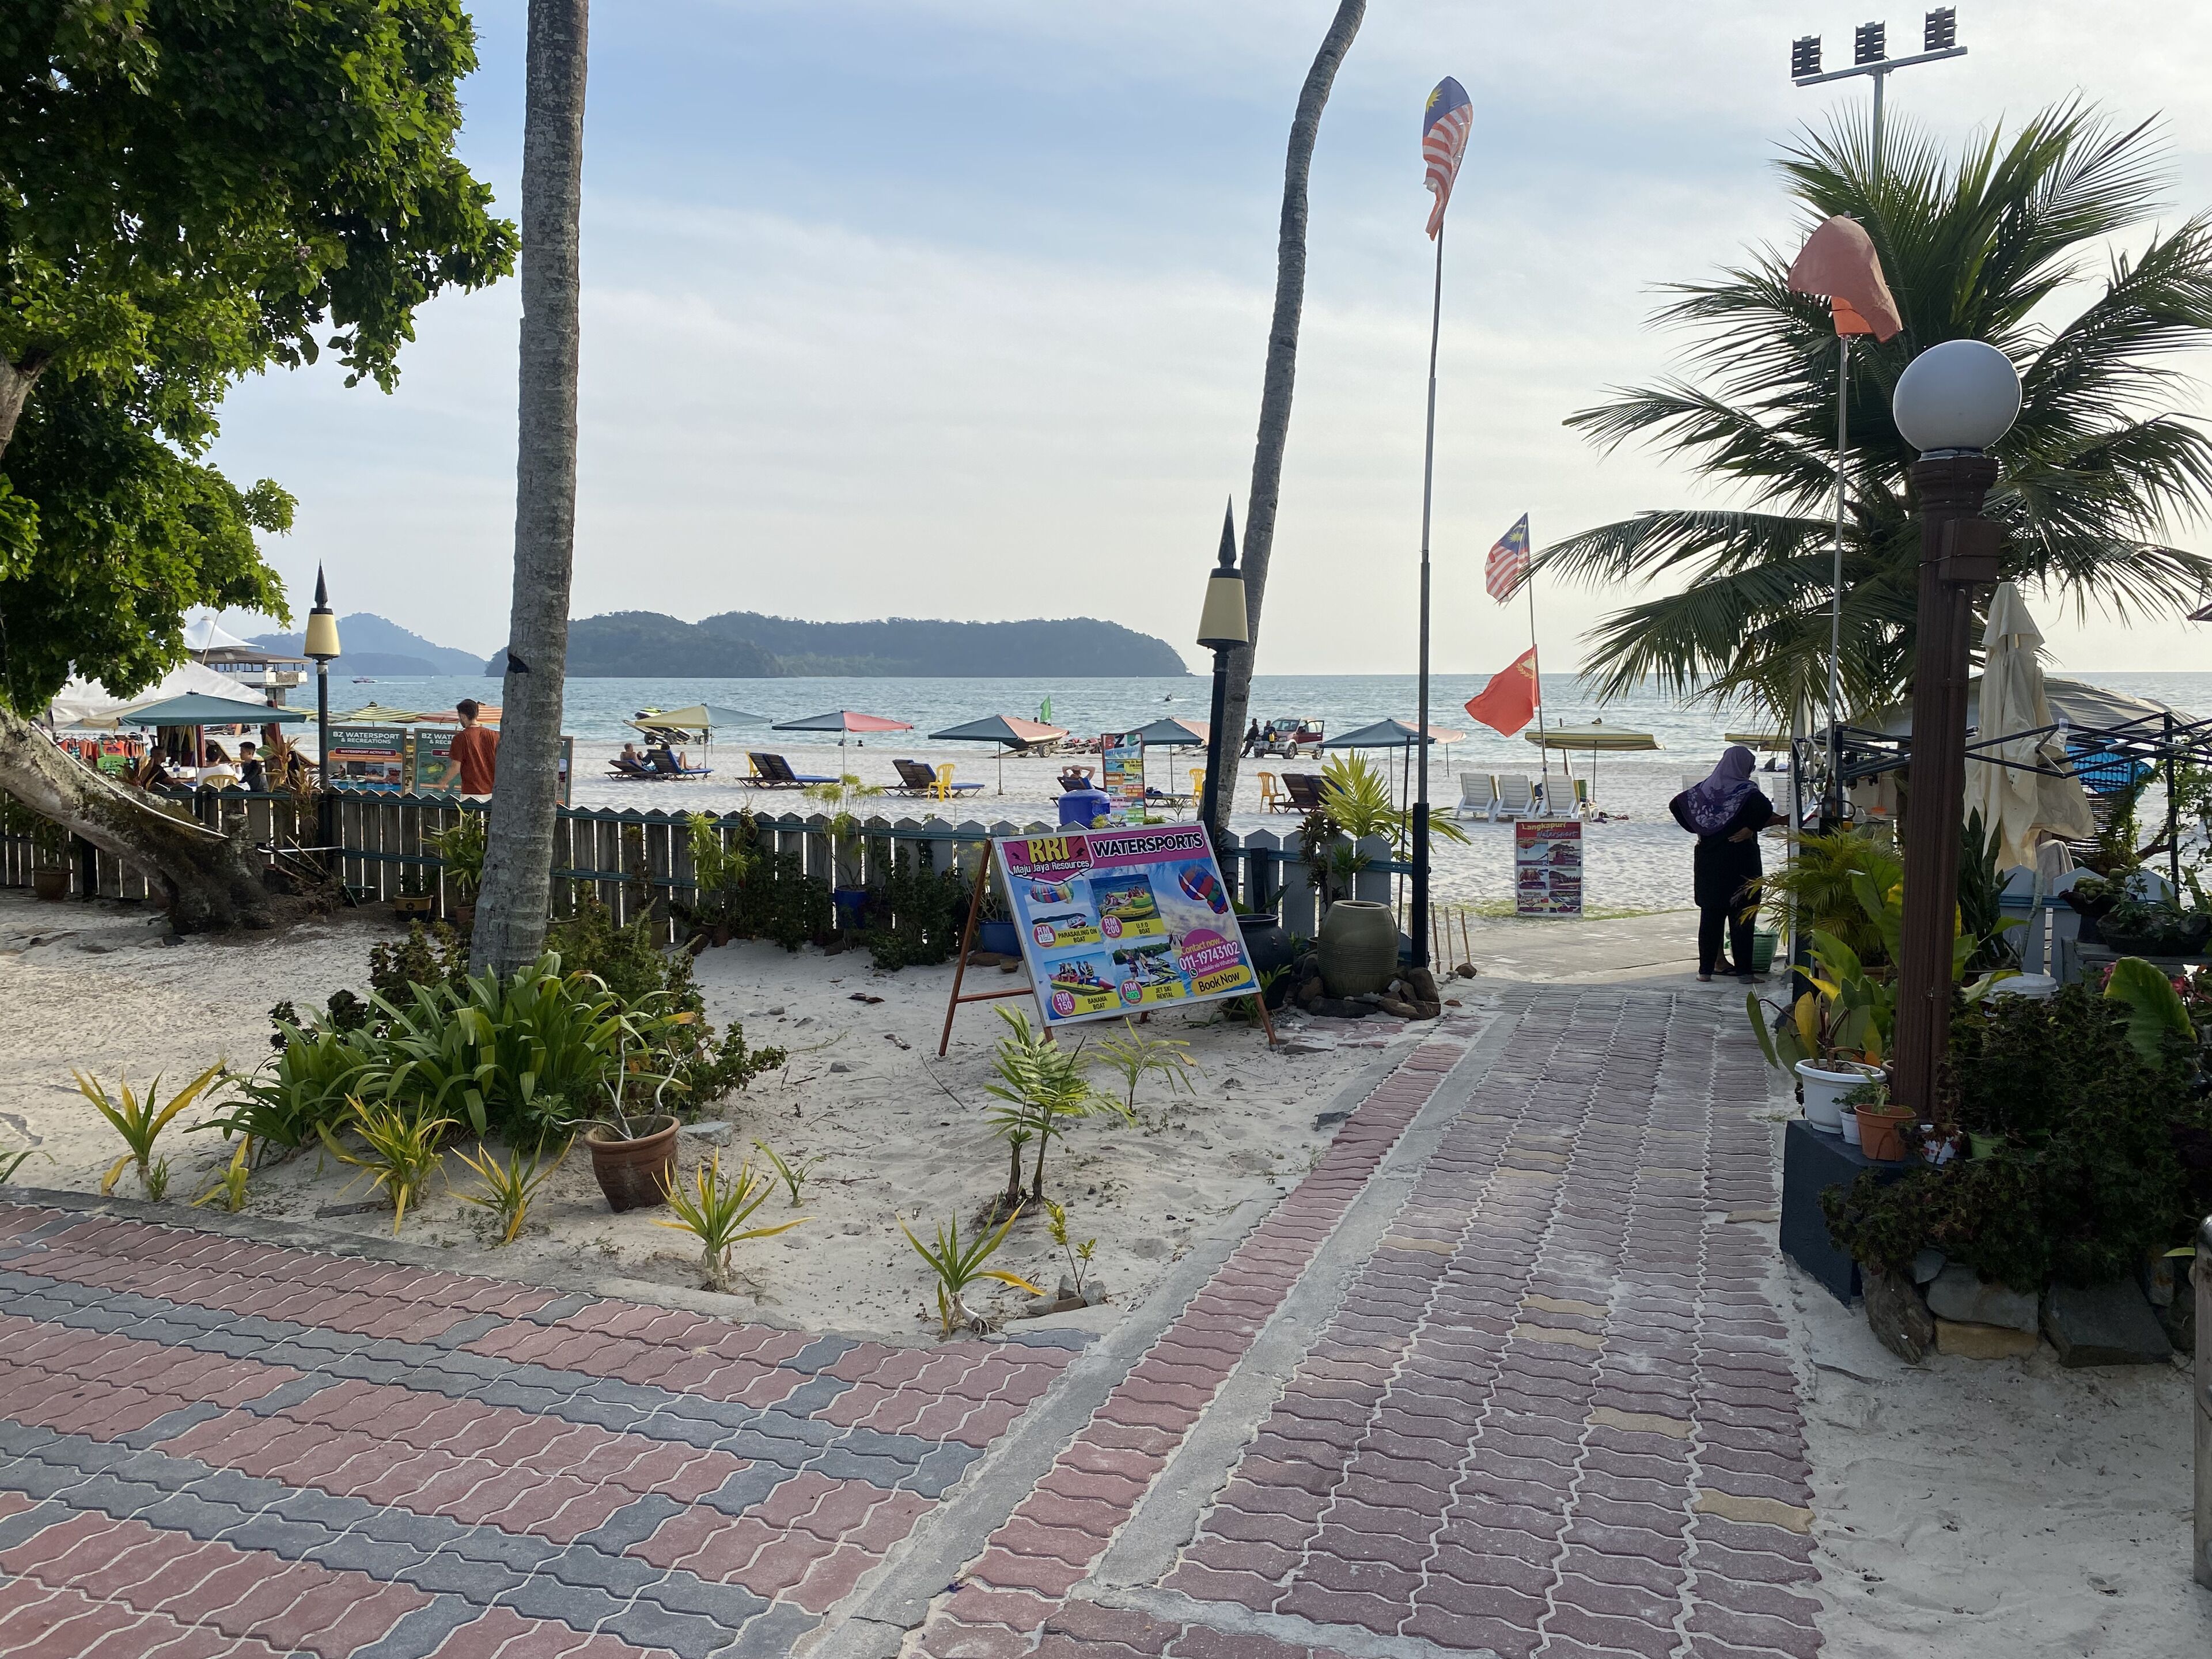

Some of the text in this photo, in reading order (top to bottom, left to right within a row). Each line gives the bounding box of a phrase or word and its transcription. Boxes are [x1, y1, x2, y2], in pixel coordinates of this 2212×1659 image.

[1105, 734, 1124, 749] BZ
[1092, 832, 1203, 857] WATERSPORTS
[1027, 837, 1071, 863] RRI
[1013, 860, 1090, 876] Maju Jaya Resources
[1104, 917, 1118, 926] RM
[1036, 926, 1051, 935] RM
[1058, 930, 1090, 938] PARASAILING
[1106, 925, 1120, 934] 200
[1181, 941, 1207, 955] Contact
[1179, 942, 1240, 971] 011-19743102
[1219, 957, 1239, 966] WhatsApp
[1198, 972, 1240, 991] Book Now
[1124, 982, 1138, 992] RM
[1056, 993, 1070, 1002] RM
[1087, 996, 1108, 1004] BANANA
[1058, 1001, 1073, 1011] 150
